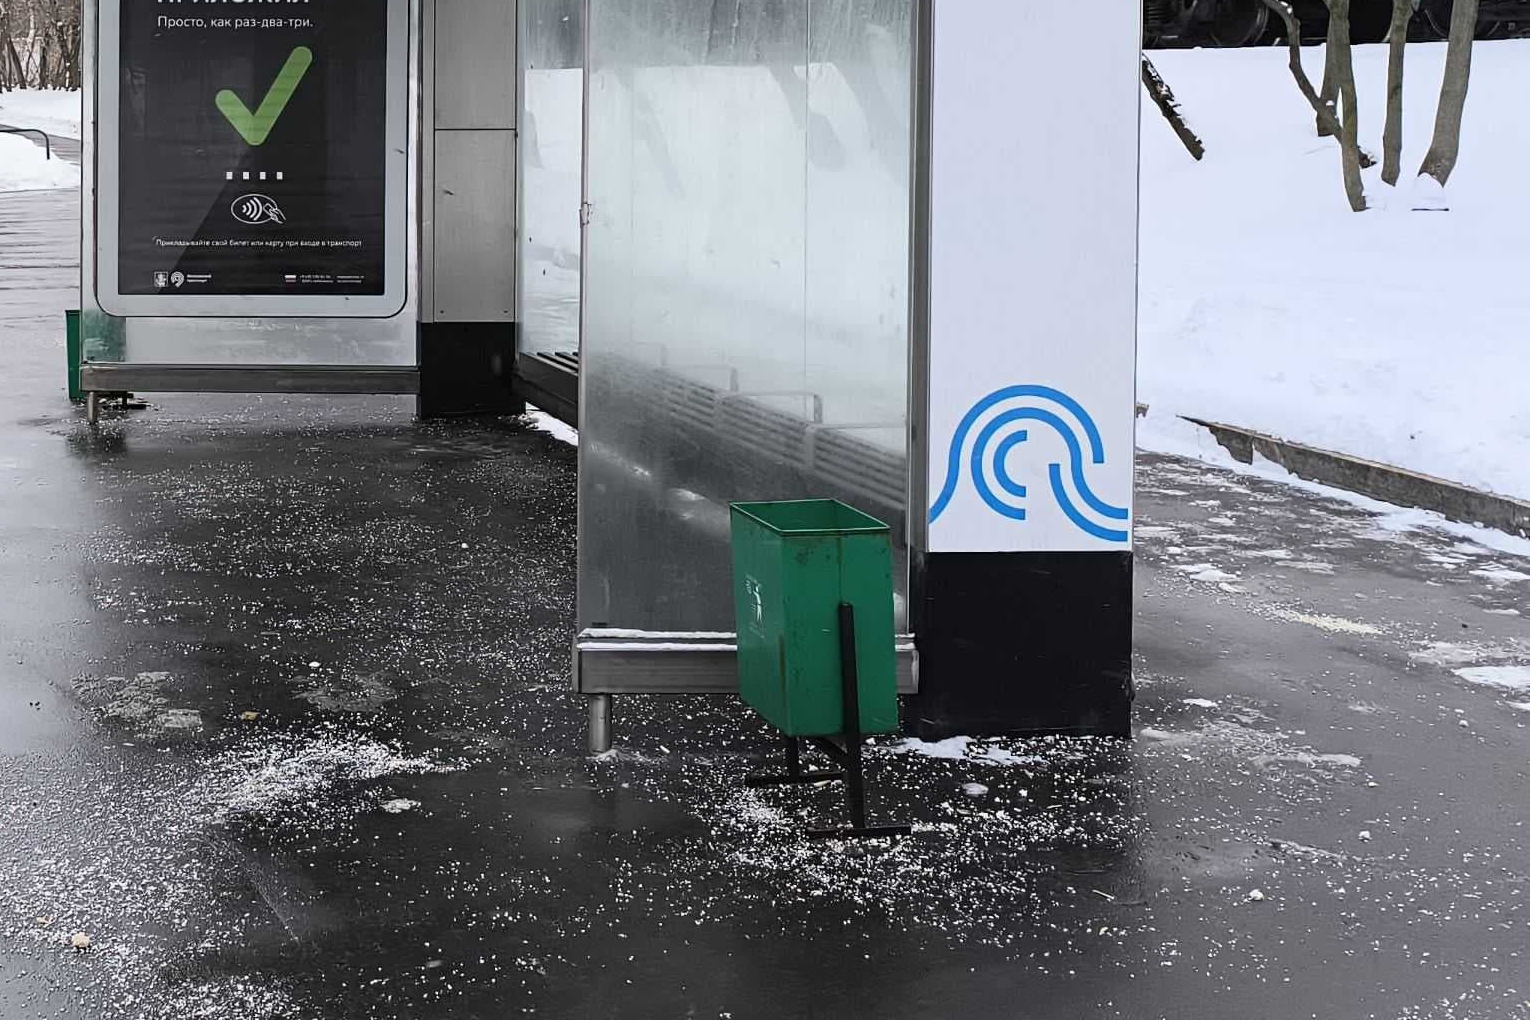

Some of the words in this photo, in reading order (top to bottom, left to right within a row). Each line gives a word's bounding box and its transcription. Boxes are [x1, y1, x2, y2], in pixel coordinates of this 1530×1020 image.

[157, 16, 207, 29] Просто,
[210, 19, 232, 27] как
[234, 18, 314, 29] раз-два-три.
